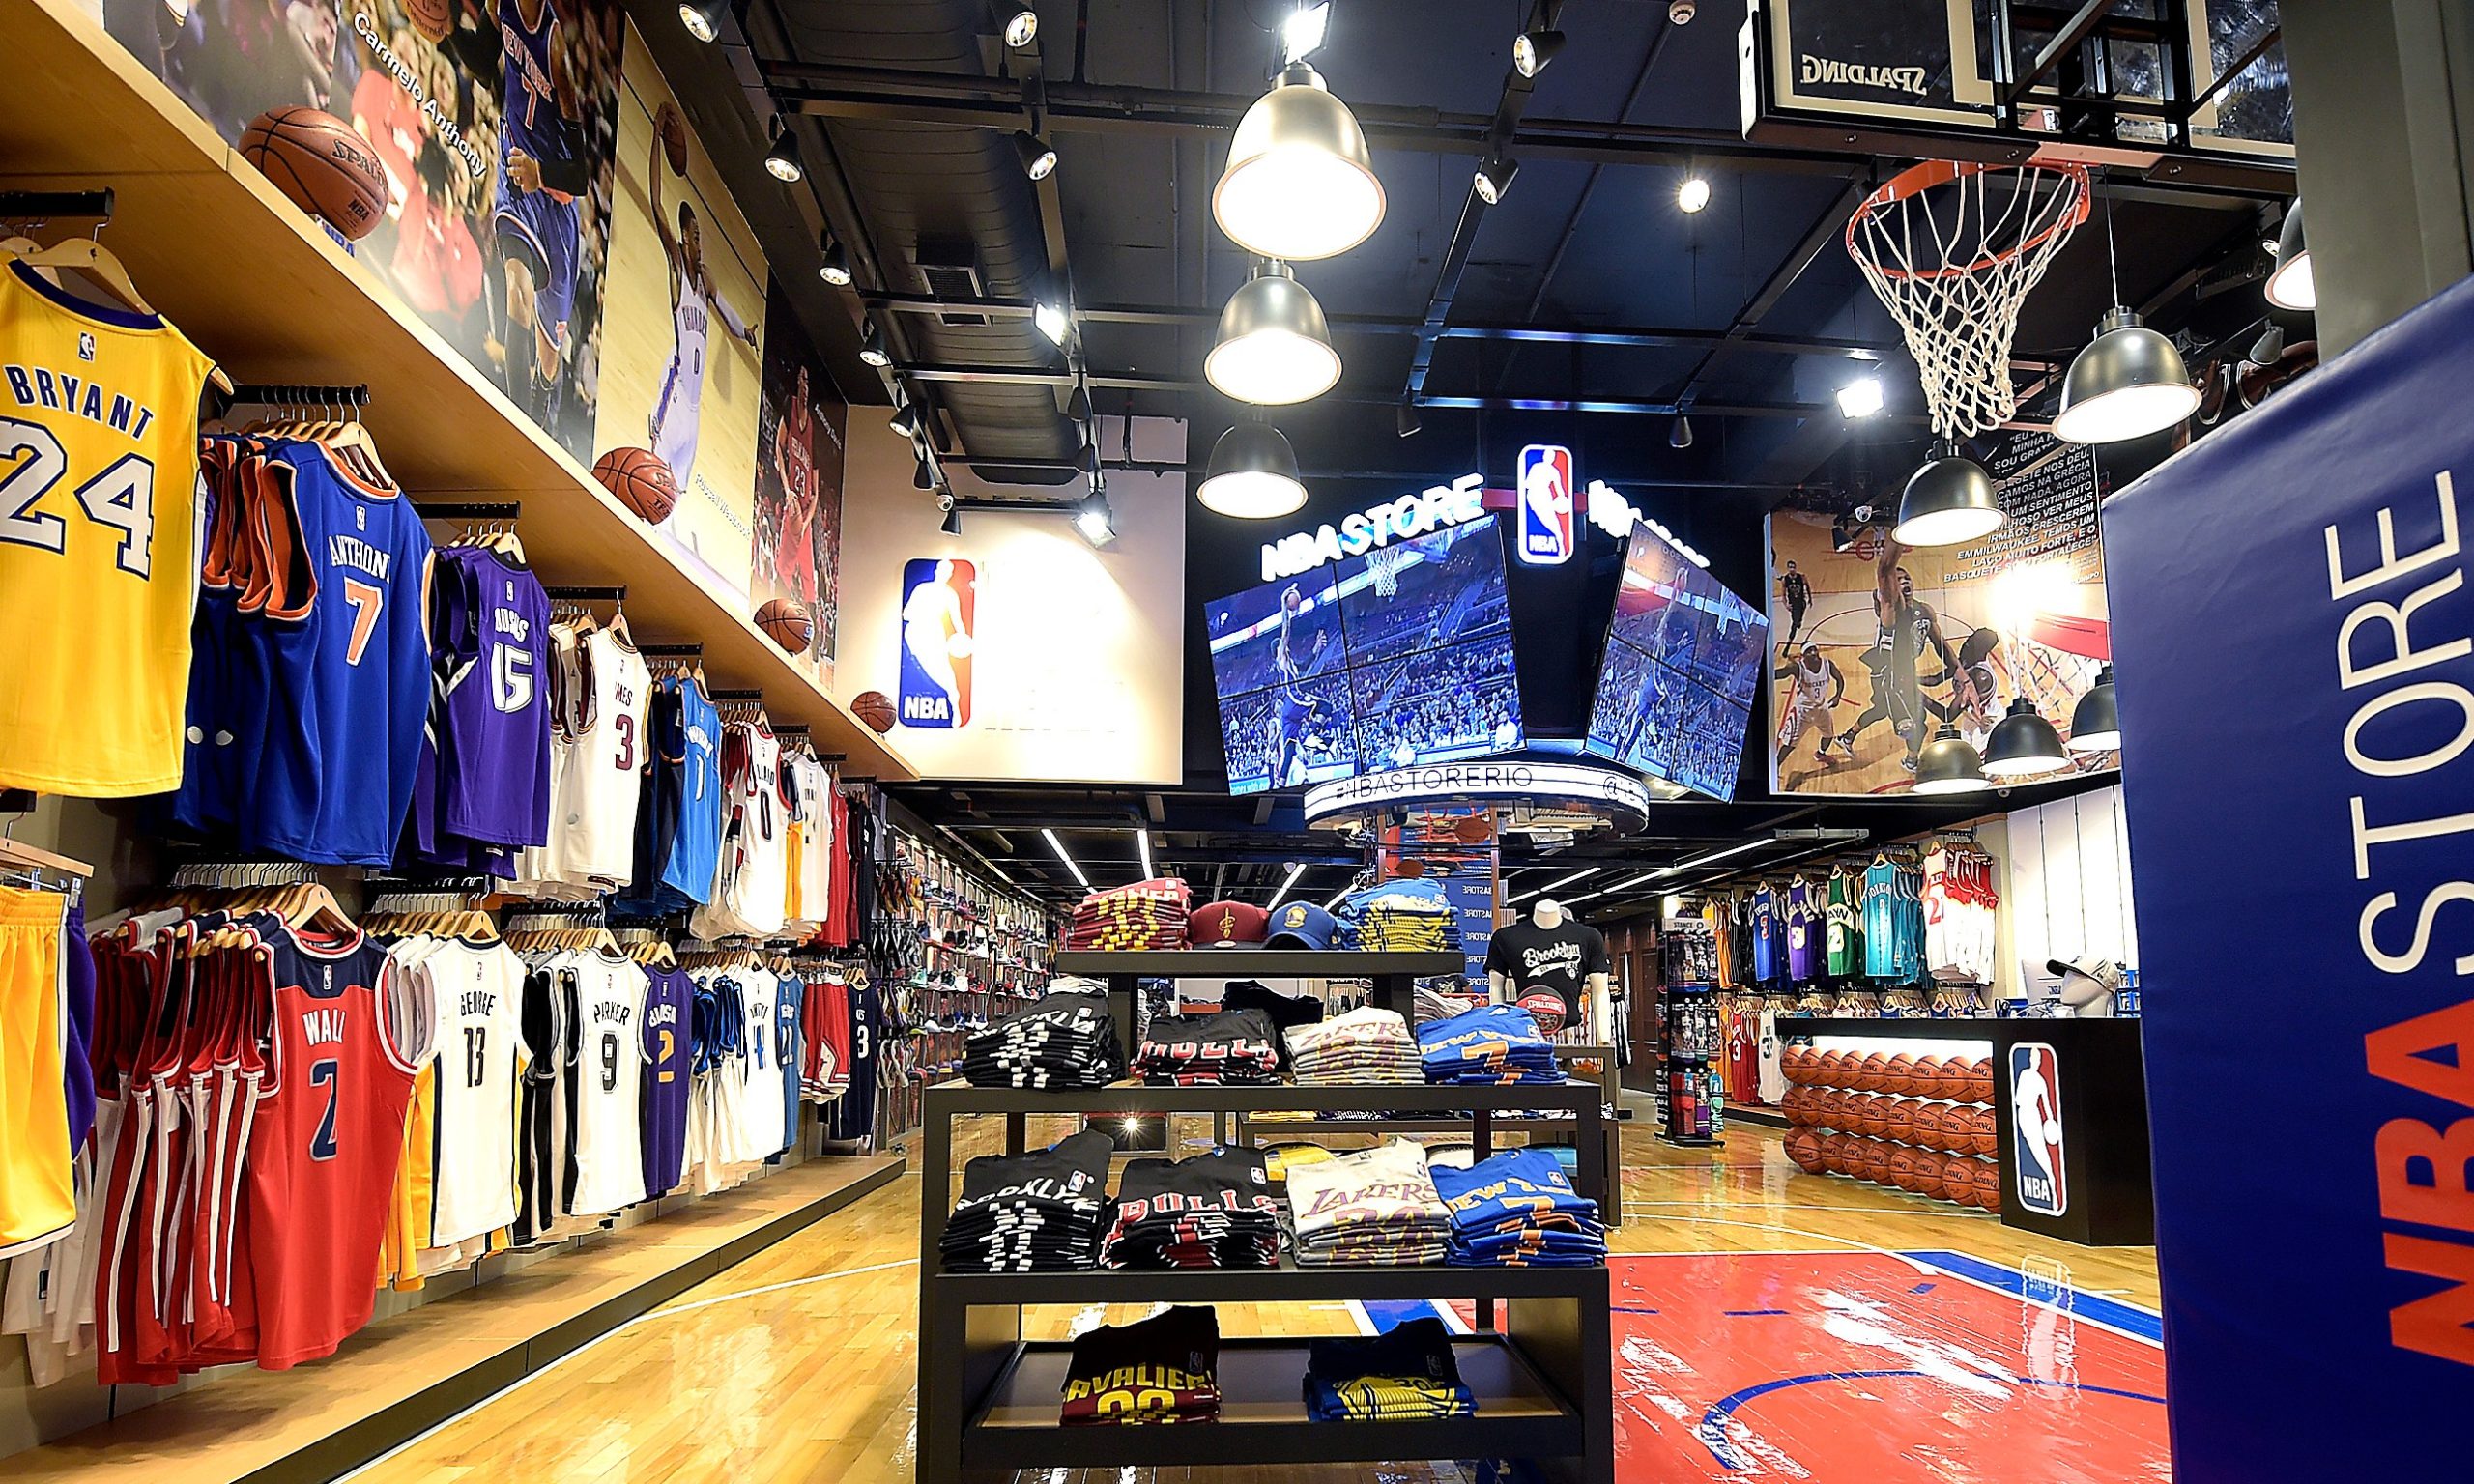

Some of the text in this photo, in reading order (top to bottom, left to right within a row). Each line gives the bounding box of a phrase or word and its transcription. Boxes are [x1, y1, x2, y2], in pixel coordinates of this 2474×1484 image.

[354, 11, 423, 104] Carmelo
[423, 98, 487, 177] Anthony
[521, 72, 537, 131] 7
[348, 198, 370, 221] NBA
[3, 364, 155, 442] BRYANT
[2012, 436, 2045, 455] MINHA
[1994, 457, 2018, 470] SOU
[2043, 460, 2065, 474] NOS
[0, 414, 155, 581] 24
[2037, 476, 2052, 487] NA
[2056, 471, 2092, 492] AGORA
[2011, 480, 2092, 518] UM SENTIMENTO
[2042, 504, 2063, 518] VER
[2064, 492, 2094, 510] MEUS
[2043, 521, 2077, 538] TEMOS
[2079, 514, 2095, 527] UM
[328, 535, 391, 585] ANTHON
[2004, 546, 2039, 561] MUITO
[1943, 564, 2003, 584] BASQUETE
[343, 577, 384, 667] 7
[491, 642, 533, 713] 15
[904, 695, 950, 720] NBA
[1336, 767, 1533, 800] #NBASTORERIO
[760, 787, 772, 842] 0
[1522, 941, 1582, 968] Brooklyn
[460, 990, 497, 1017] GEORGE
[593, 1000, 631, 1026] PARKER
[302, 1009, 346, 1046] WALL
[857, 1024, 870, 1059] 3
[1301, 1021, 1408, 1049] LAKERS
[464, 1027, 486, 1088] 13
[601, 1030, 620, 1094] 9
[657, 1029, 676, 1083] 2
[1733, 1039, 1740, 1061] 3
[308, 1057, 338, 1162] 2
[1301, 1182, 1440, 1219] LAKERS
[2023, 1175, 2052, 1202] NBA
[1065, 1361, 1222, 1403] AVALIER
